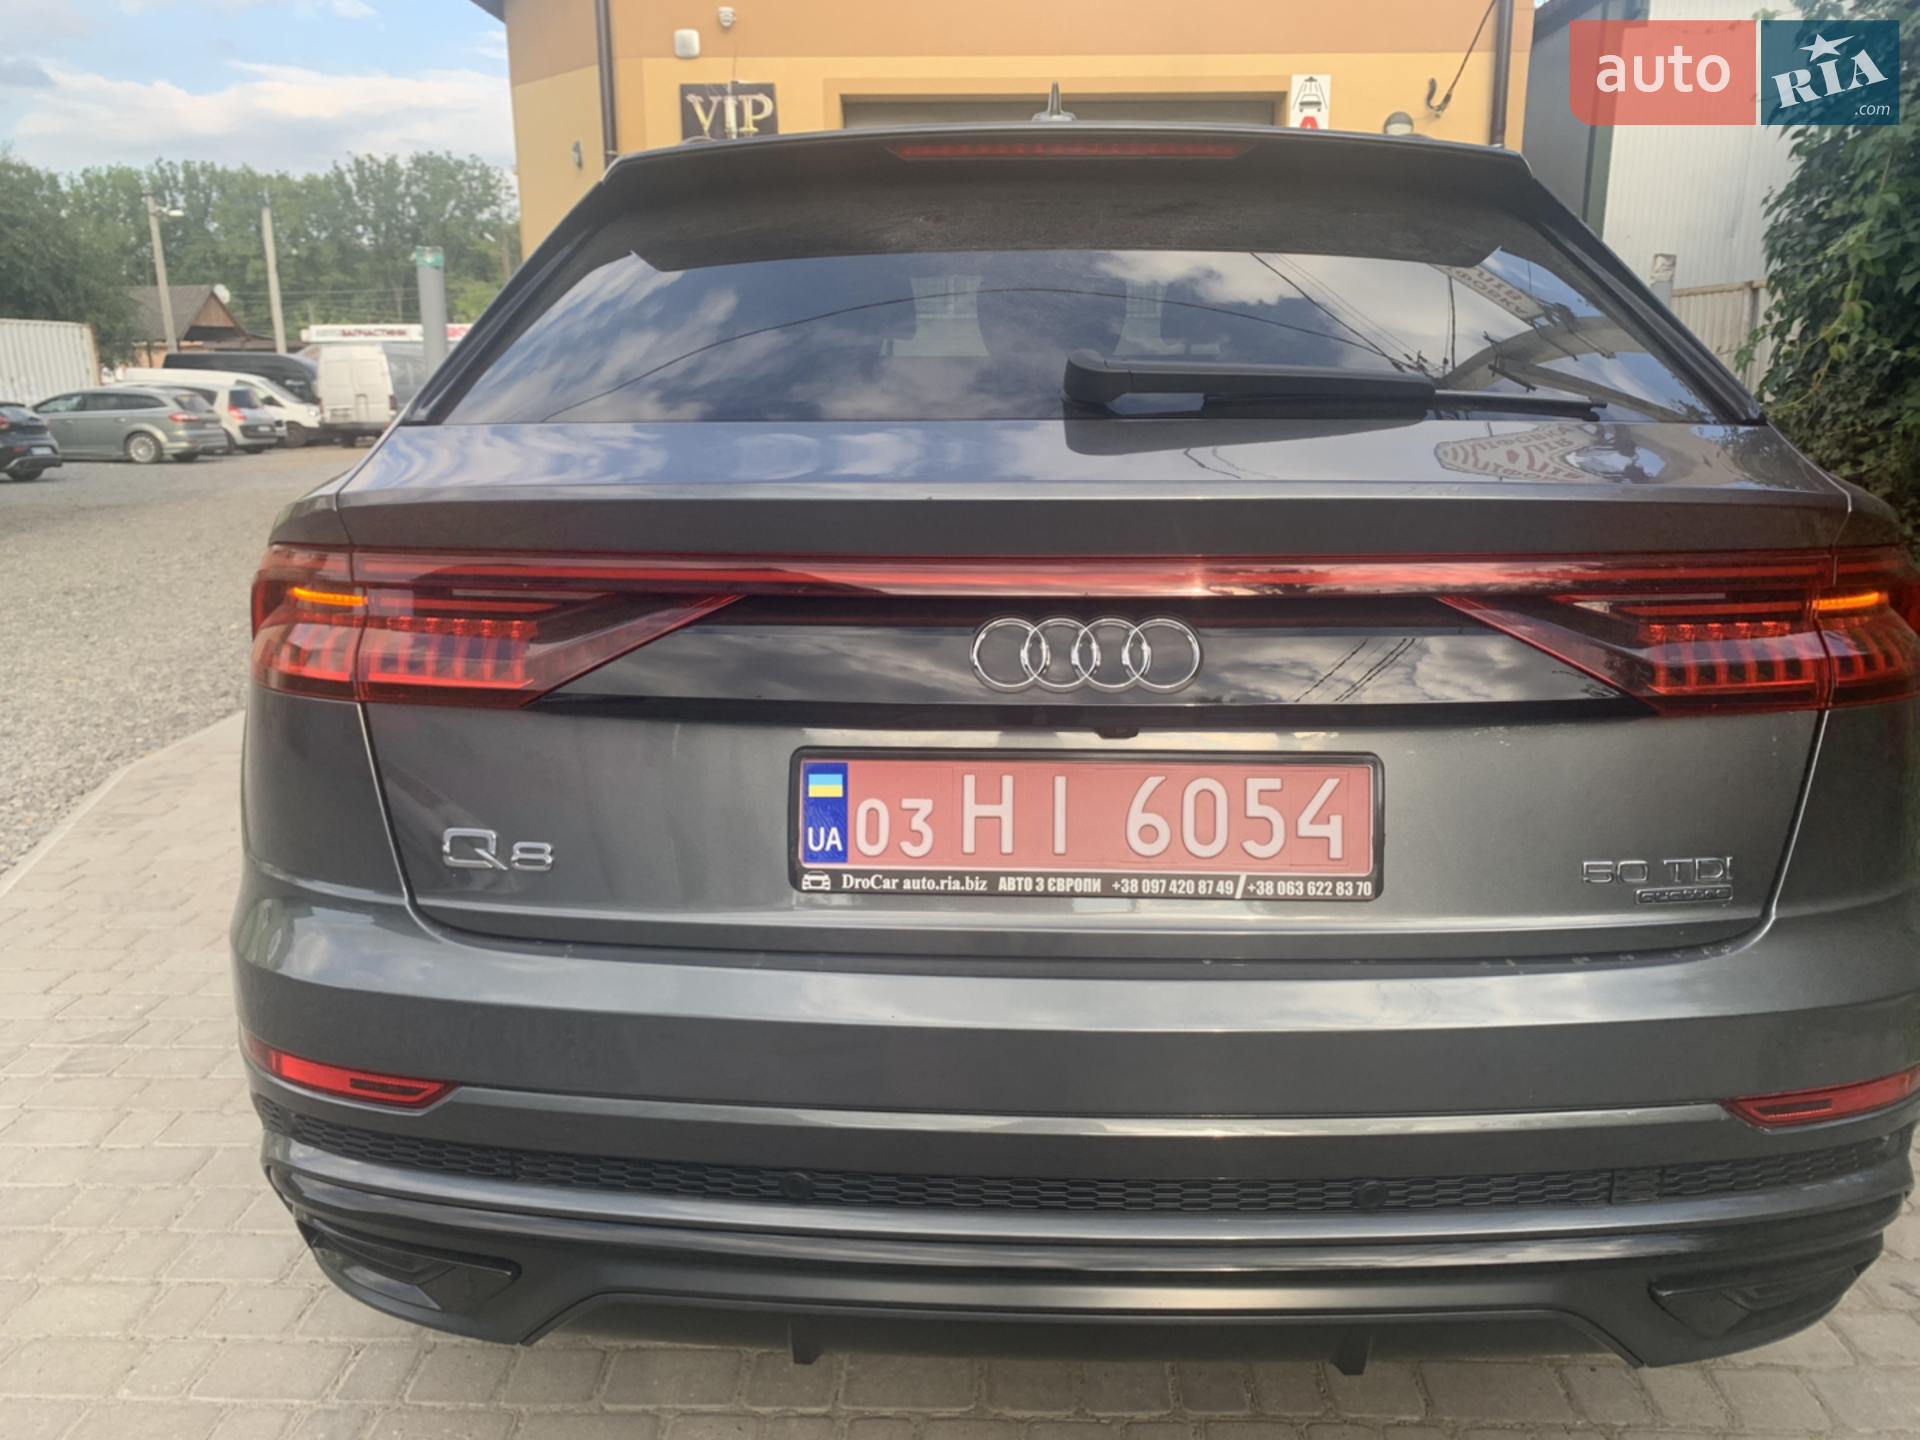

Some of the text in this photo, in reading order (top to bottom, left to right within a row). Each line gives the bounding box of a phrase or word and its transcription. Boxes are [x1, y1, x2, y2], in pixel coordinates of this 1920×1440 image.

[685, 93, 773, 136] VIP
[855, 799, 934, 858] 03
[1125, 775, 1344, 860] 6054
[442, 827, 553, 871] Q8
[807, 827, 843, 851] UA
[841, 874, 898, 890] DroCar
[903, 876, 987, 891] auto.ria.biz
[1112, 878, 1138, 894] +38
[1141, 879, 1167, 894] 097
[1169, 879, 1193, 895] 420
[1198, 880, 1213, 895] 87
[1277, 881, 1304, 896] 063
[1307, 881, 1333, 896] 622
[1336, 881, 1354, 897] 83
[1356, 881, 1373, 896] 70
[1582, 856, 1733, 884] 50 TDI
